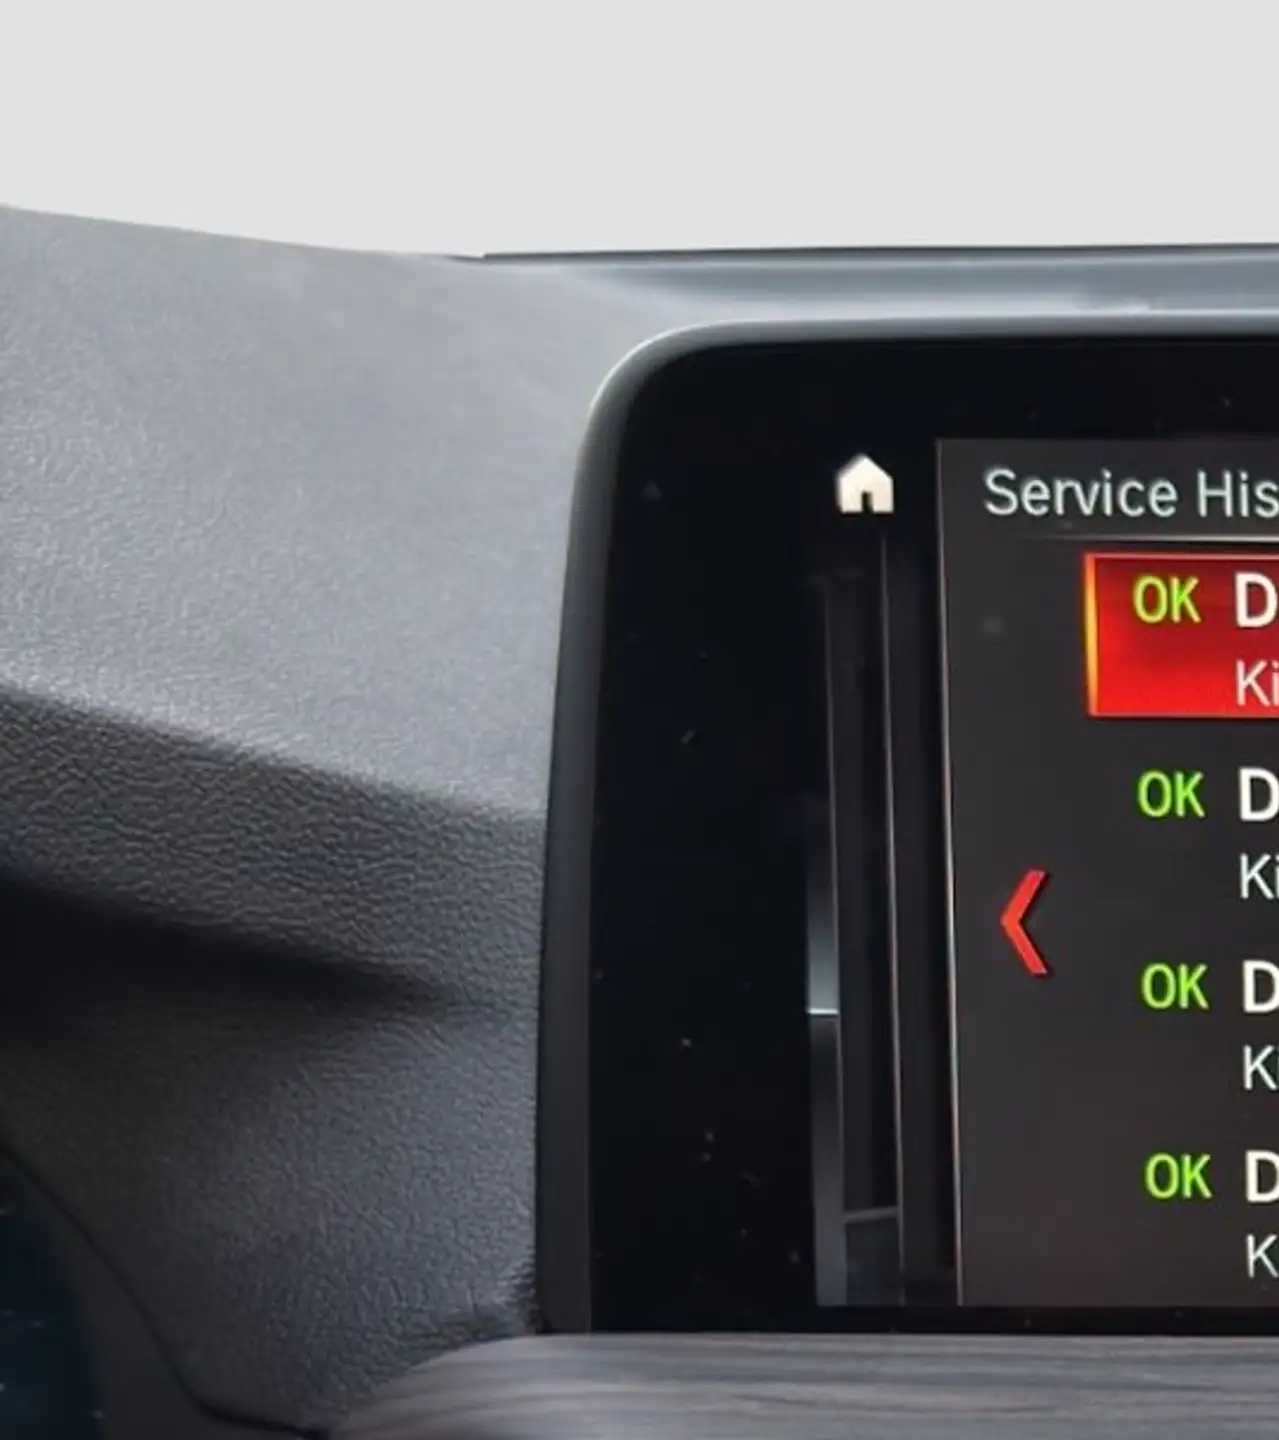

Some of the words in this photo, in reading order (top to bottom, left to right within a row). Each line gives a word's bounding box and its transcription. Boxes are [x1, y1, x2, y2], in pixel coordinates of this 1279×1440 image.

[983, 466, 1180, 519] Service
[1131, 573, 1203, 625] OK
[1136, 768, 1207, 819] OK
[1140, 961, 1210, 1011] OK
[1143, 1151, 1214, 1201] OK
